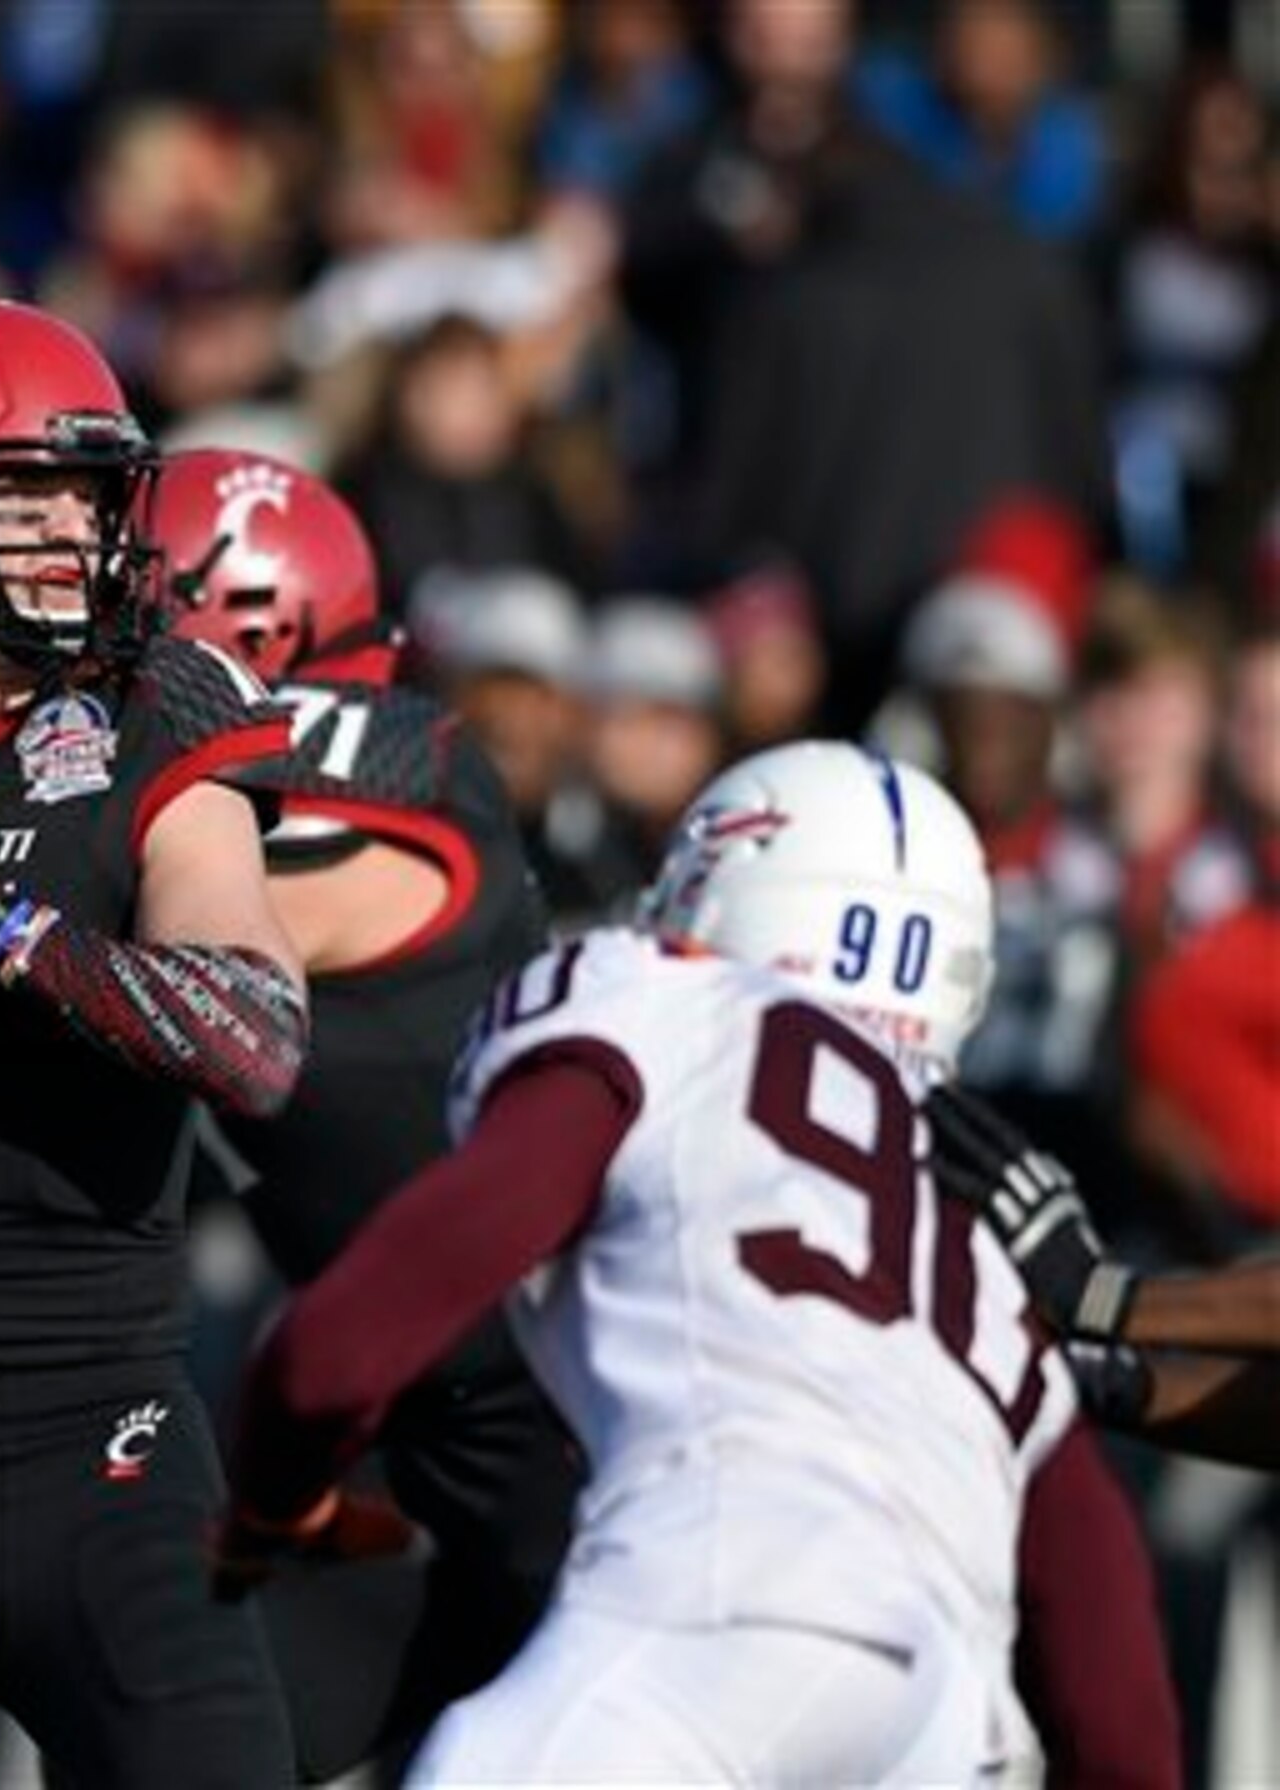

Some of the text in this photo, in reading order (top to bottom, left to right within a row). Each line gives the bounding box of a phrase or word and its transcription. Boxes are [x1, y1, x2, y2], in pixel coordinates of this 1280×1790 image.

[270, 684, 370, 782] 71
[833, 903, 933, 996] 90
[732, 1000, 1046, 1452] 90
